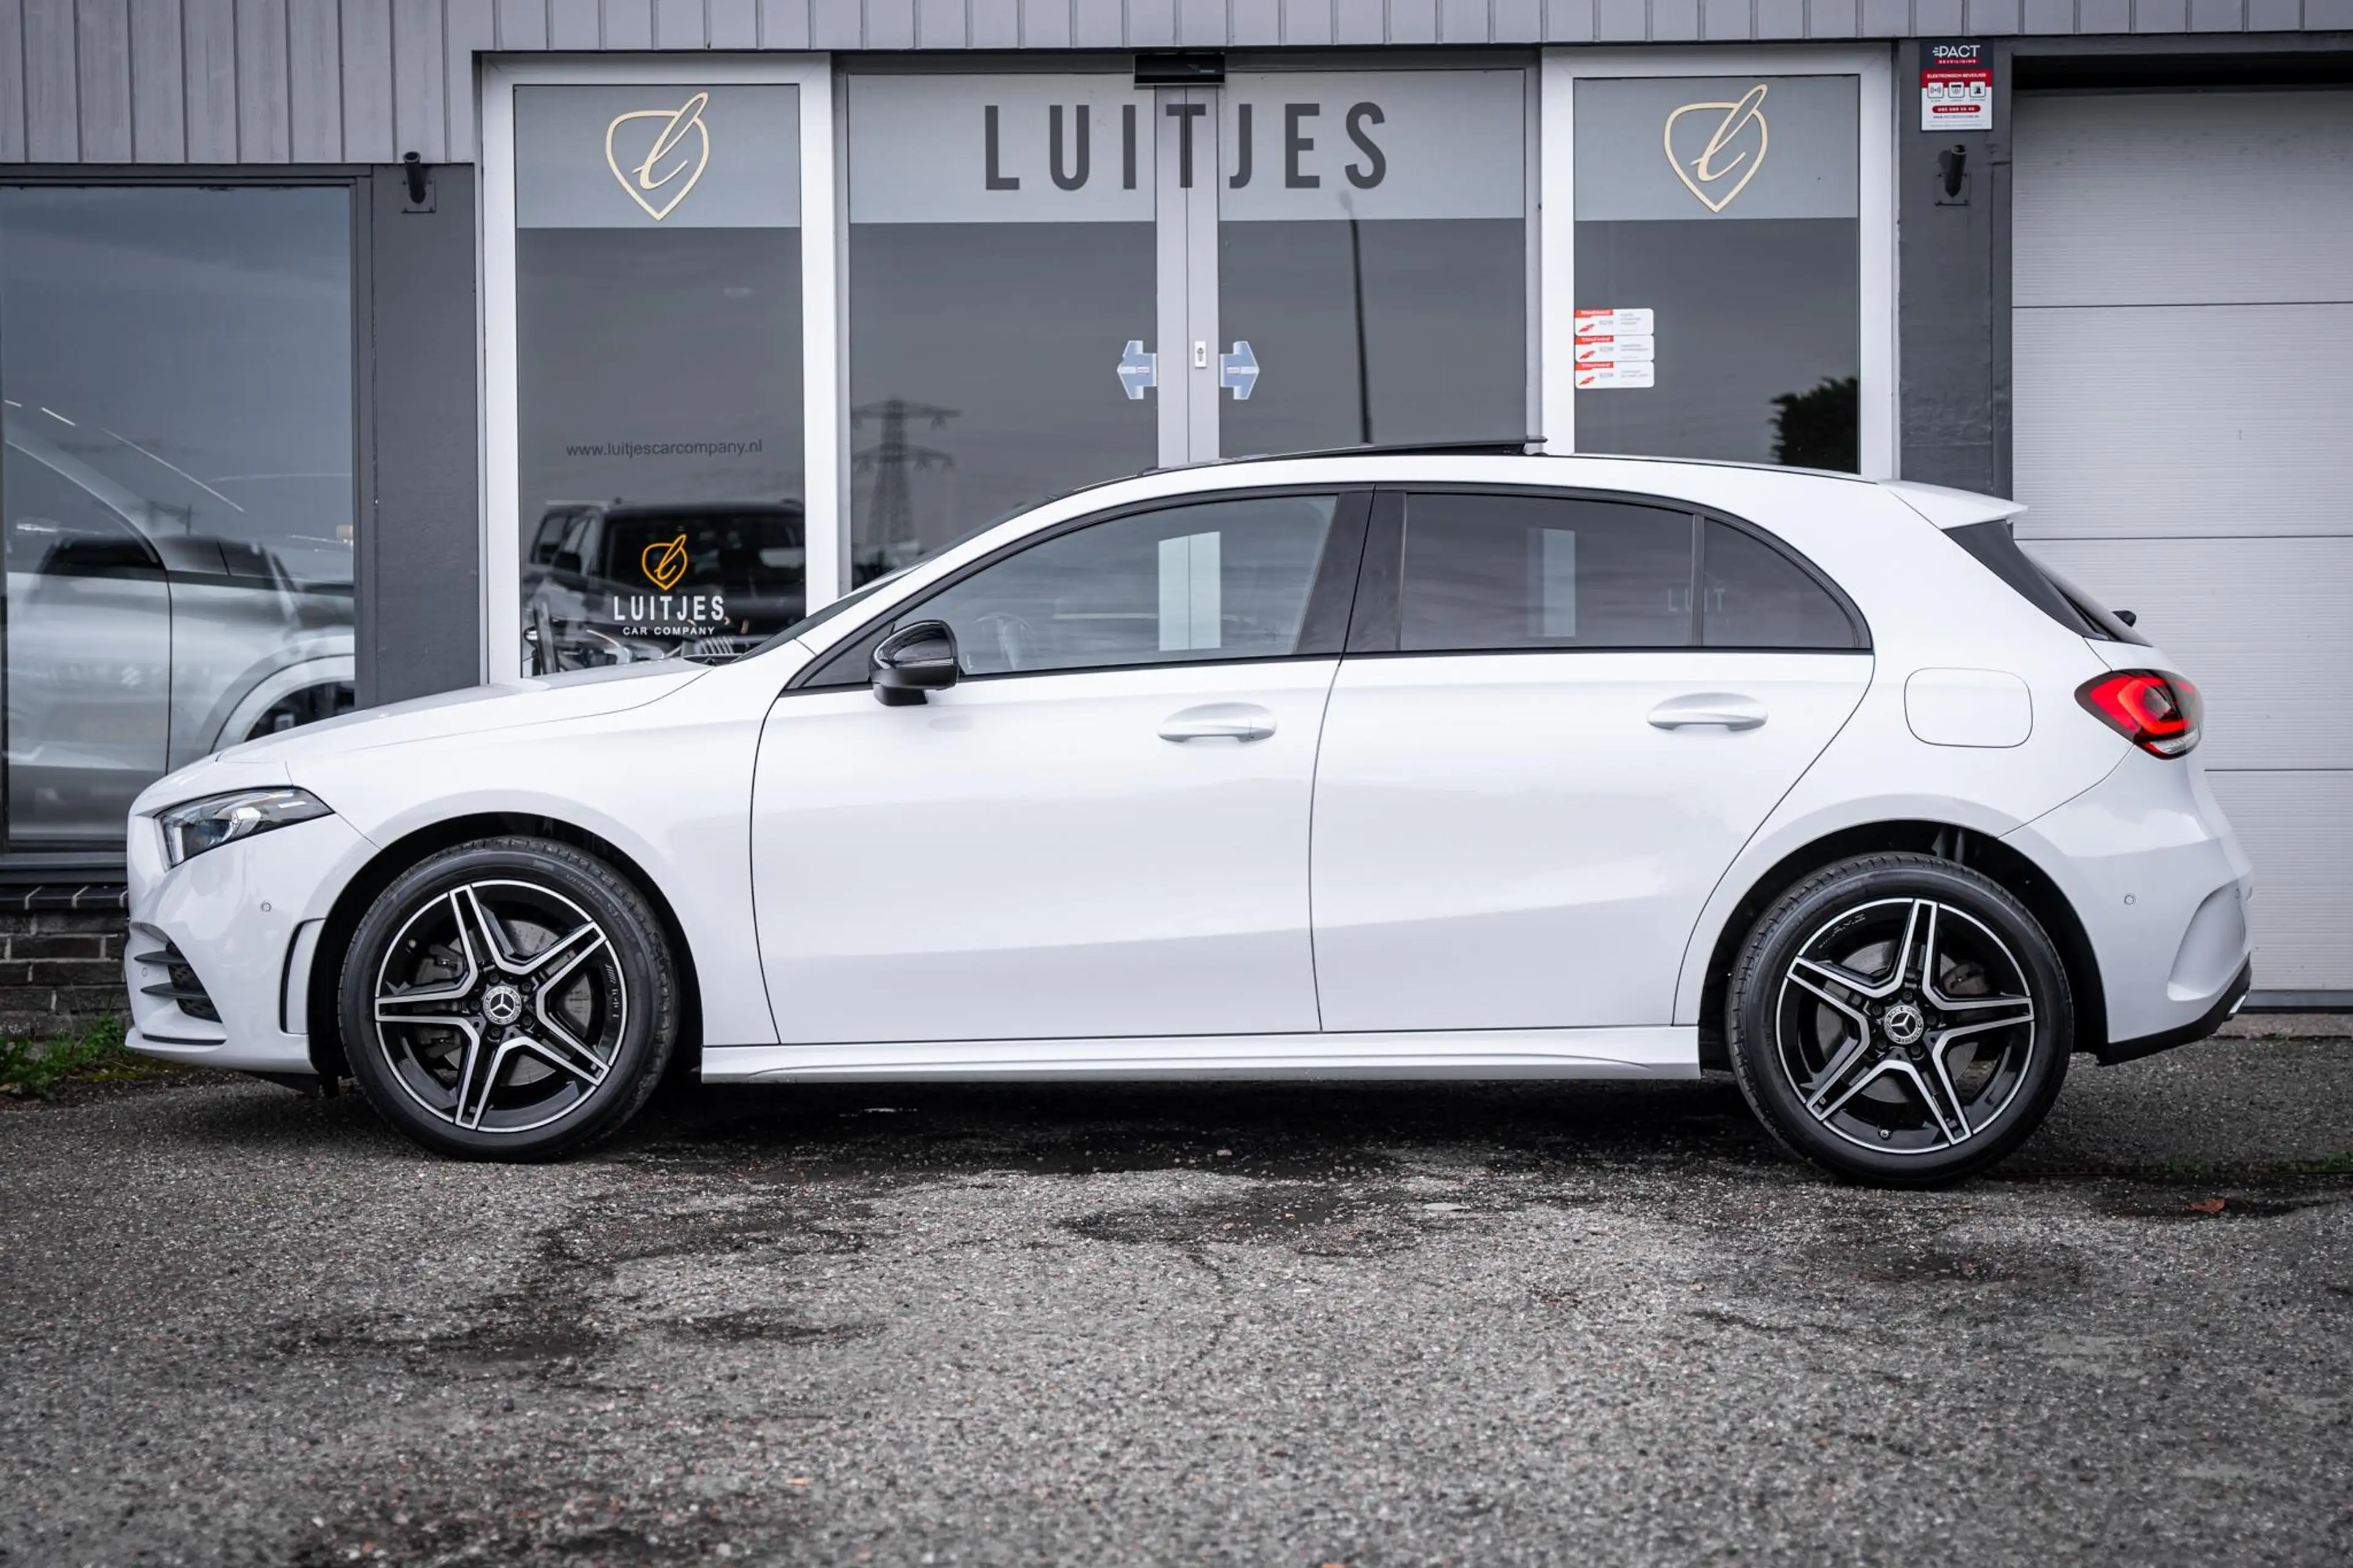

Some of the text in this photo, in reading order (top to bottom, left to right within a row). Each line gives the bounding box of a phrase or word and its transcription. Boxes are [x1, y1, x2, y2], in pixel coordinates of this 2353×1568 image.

[1938, 45, 1980, 58] PACT
[984, 101, 1387, 191] LUITJES
[566, 439, 763, 460] www.luitjescarcompany.nl
[613, 595, 726, 621] LUITJES
[623, 626, 716, 636] CAR COMPANY
